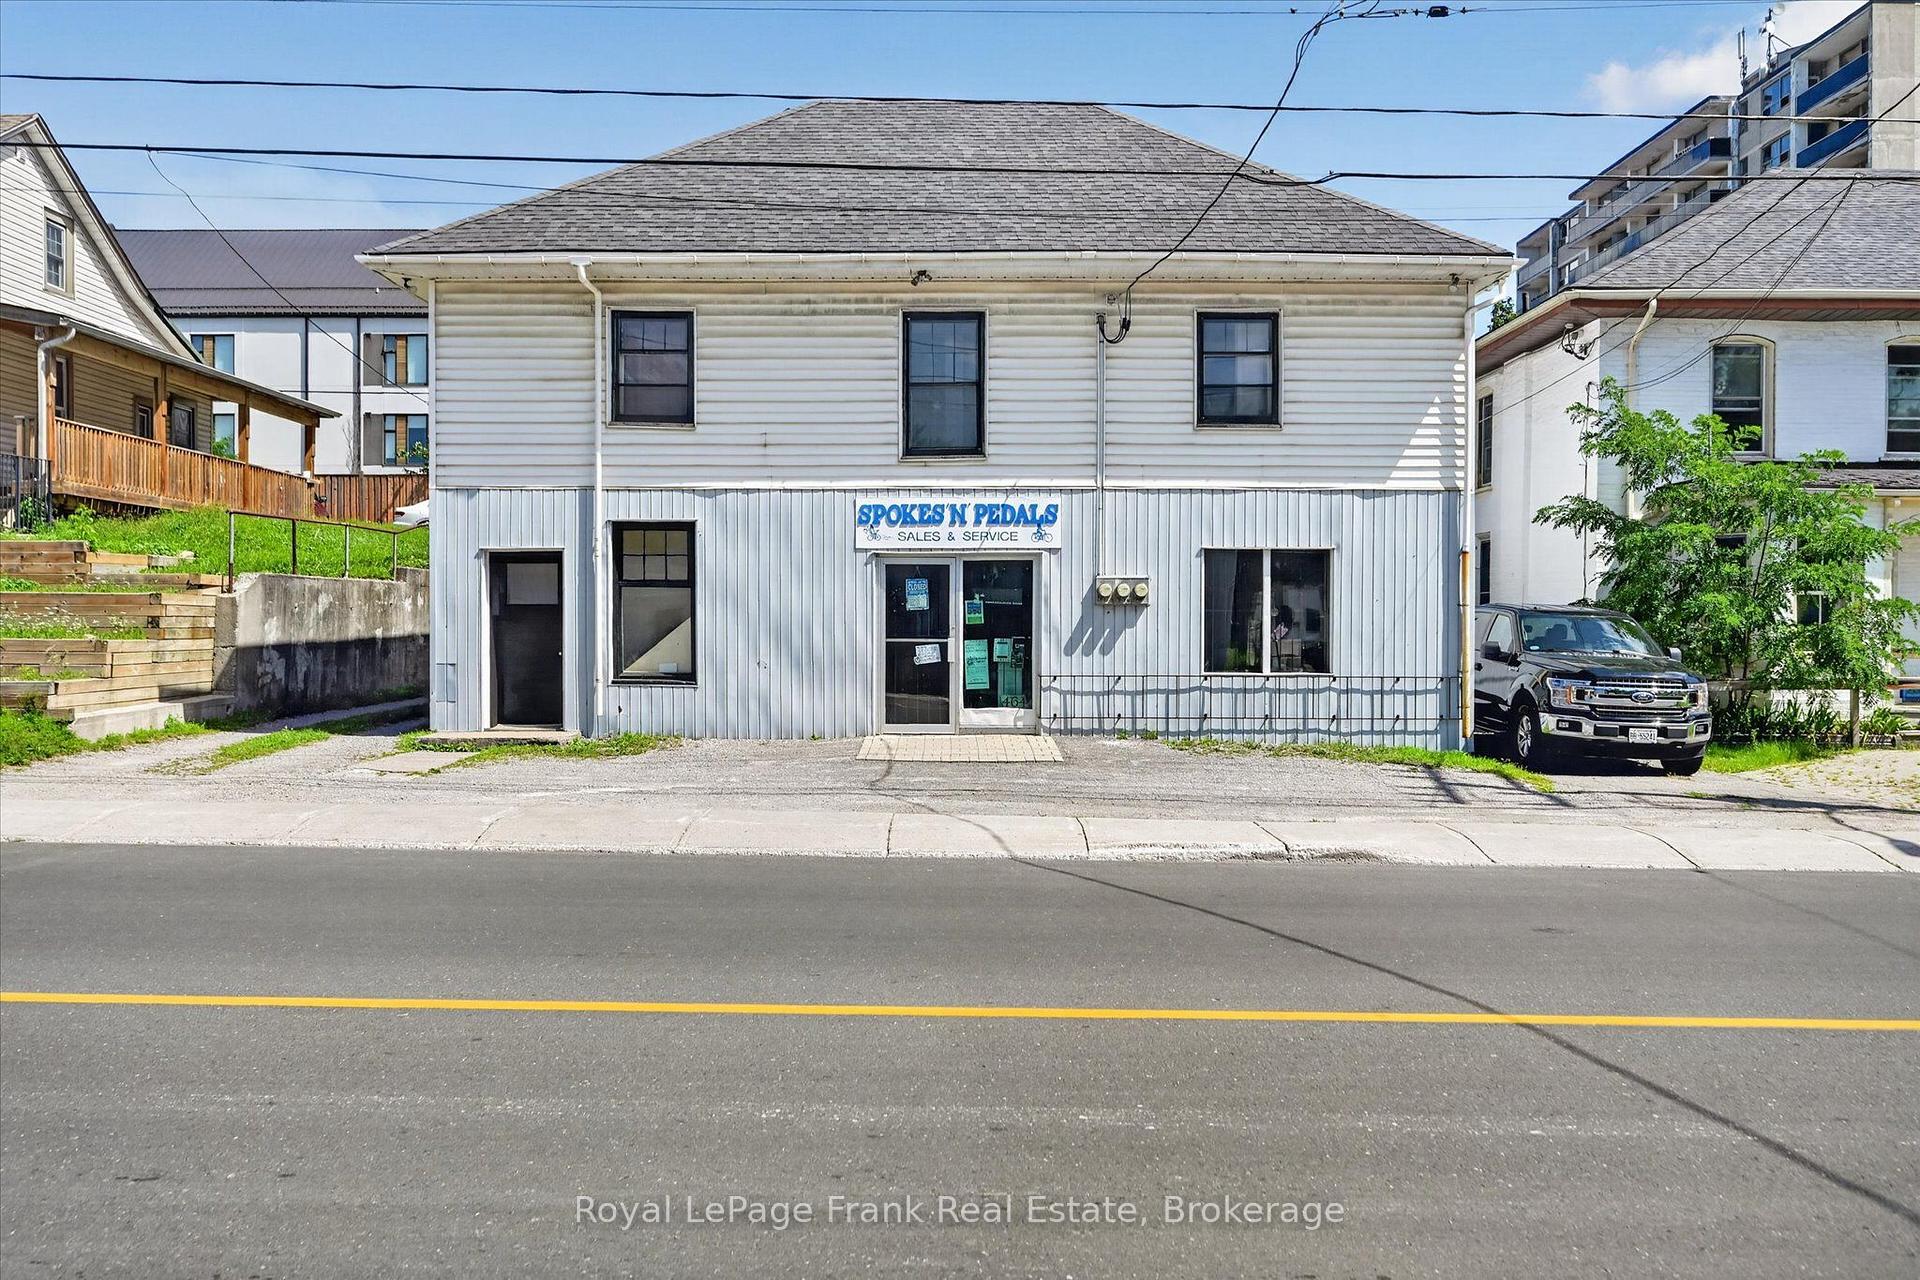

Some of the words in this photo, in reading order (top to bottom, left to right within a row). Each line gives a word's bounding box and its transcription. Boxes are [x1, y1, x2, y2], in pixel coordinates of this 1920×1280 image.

[973, 503, 1059, 527] PEDALS
[897, 531, 941, 542] SALES
[947, 531, 956, 542] &
[962, 531, 1019, 542] SERVICE
[907, 583, 928, 591] CLOSED
